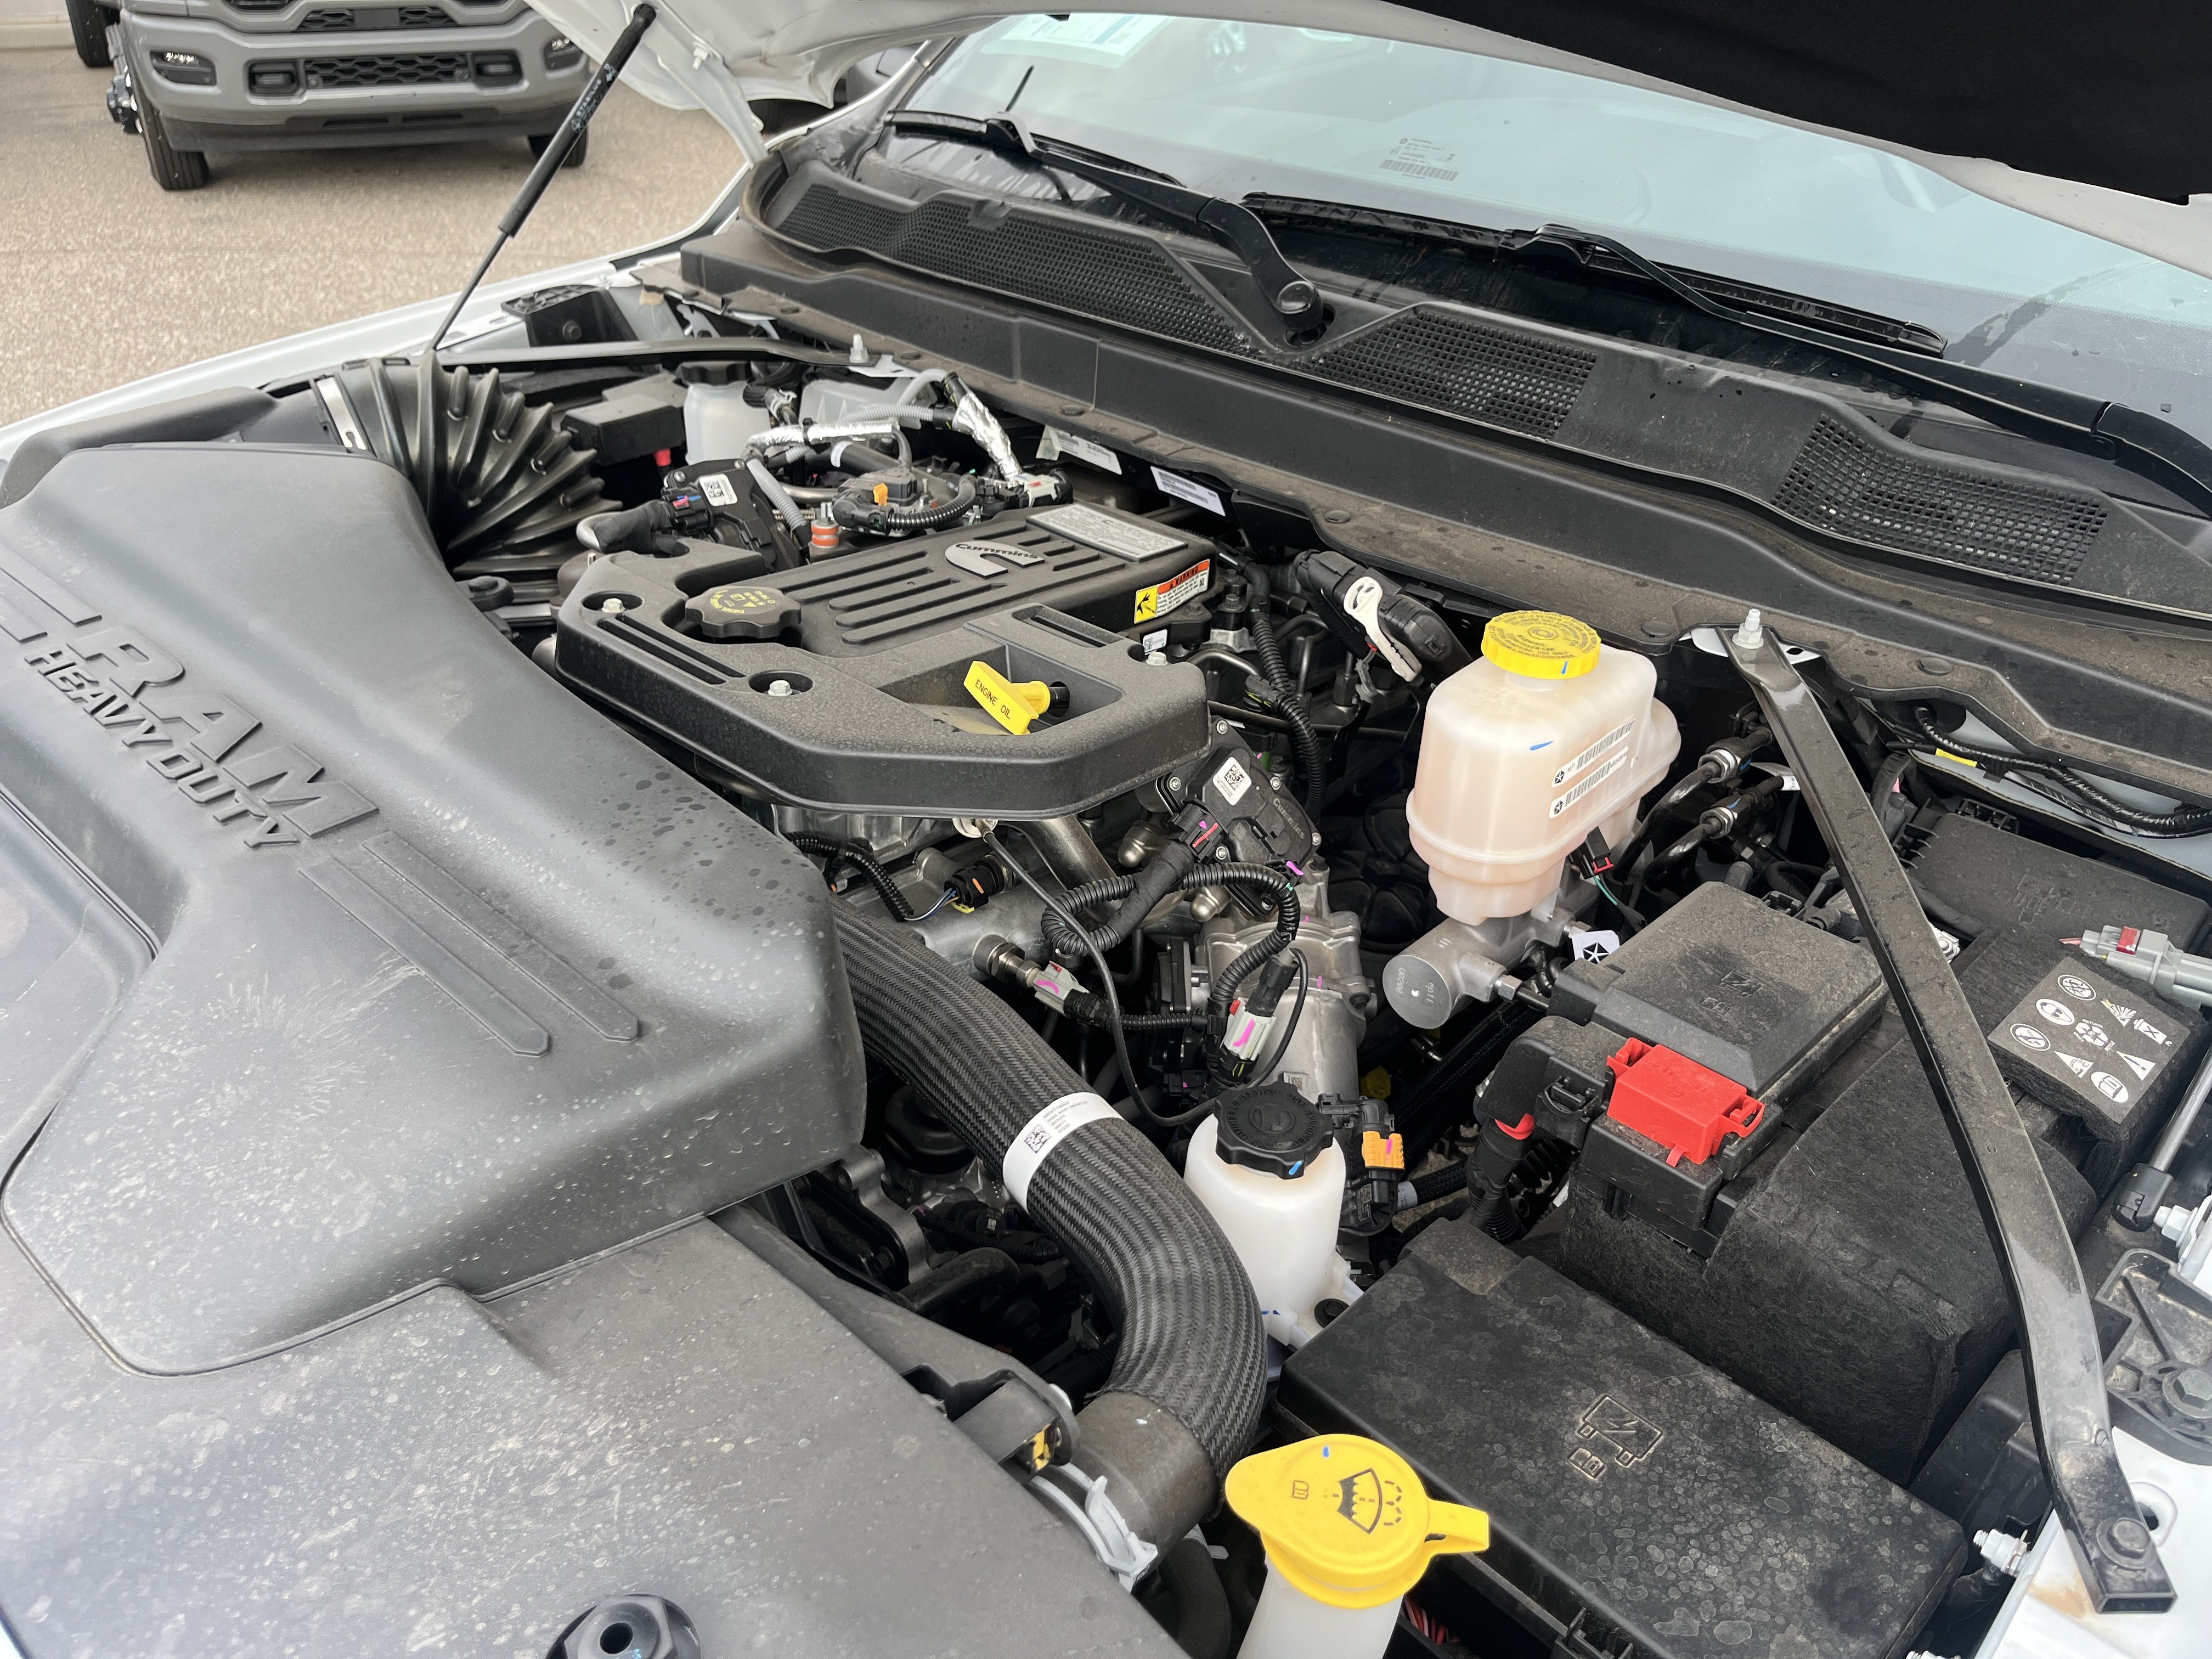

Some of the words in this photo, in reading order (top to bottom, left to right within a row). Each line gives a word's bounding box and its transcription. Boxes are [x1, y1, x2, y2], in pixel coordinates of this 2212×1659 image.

[955, 543, 1039, 559] Cummins
[1175, 566, 1199, 585] WARNING
[974, 679, 998, 706] ENGINE
[1000, 704, 1011, 720] OIL
[24, 650, 173, 748] HEAVY
[146, 747, 301, 850] DUTY
[67, 622, 381, 839] RAM
[1272, 797, 1306, 840] Cummins
[1287, 1092, 1306, 1108] USE
